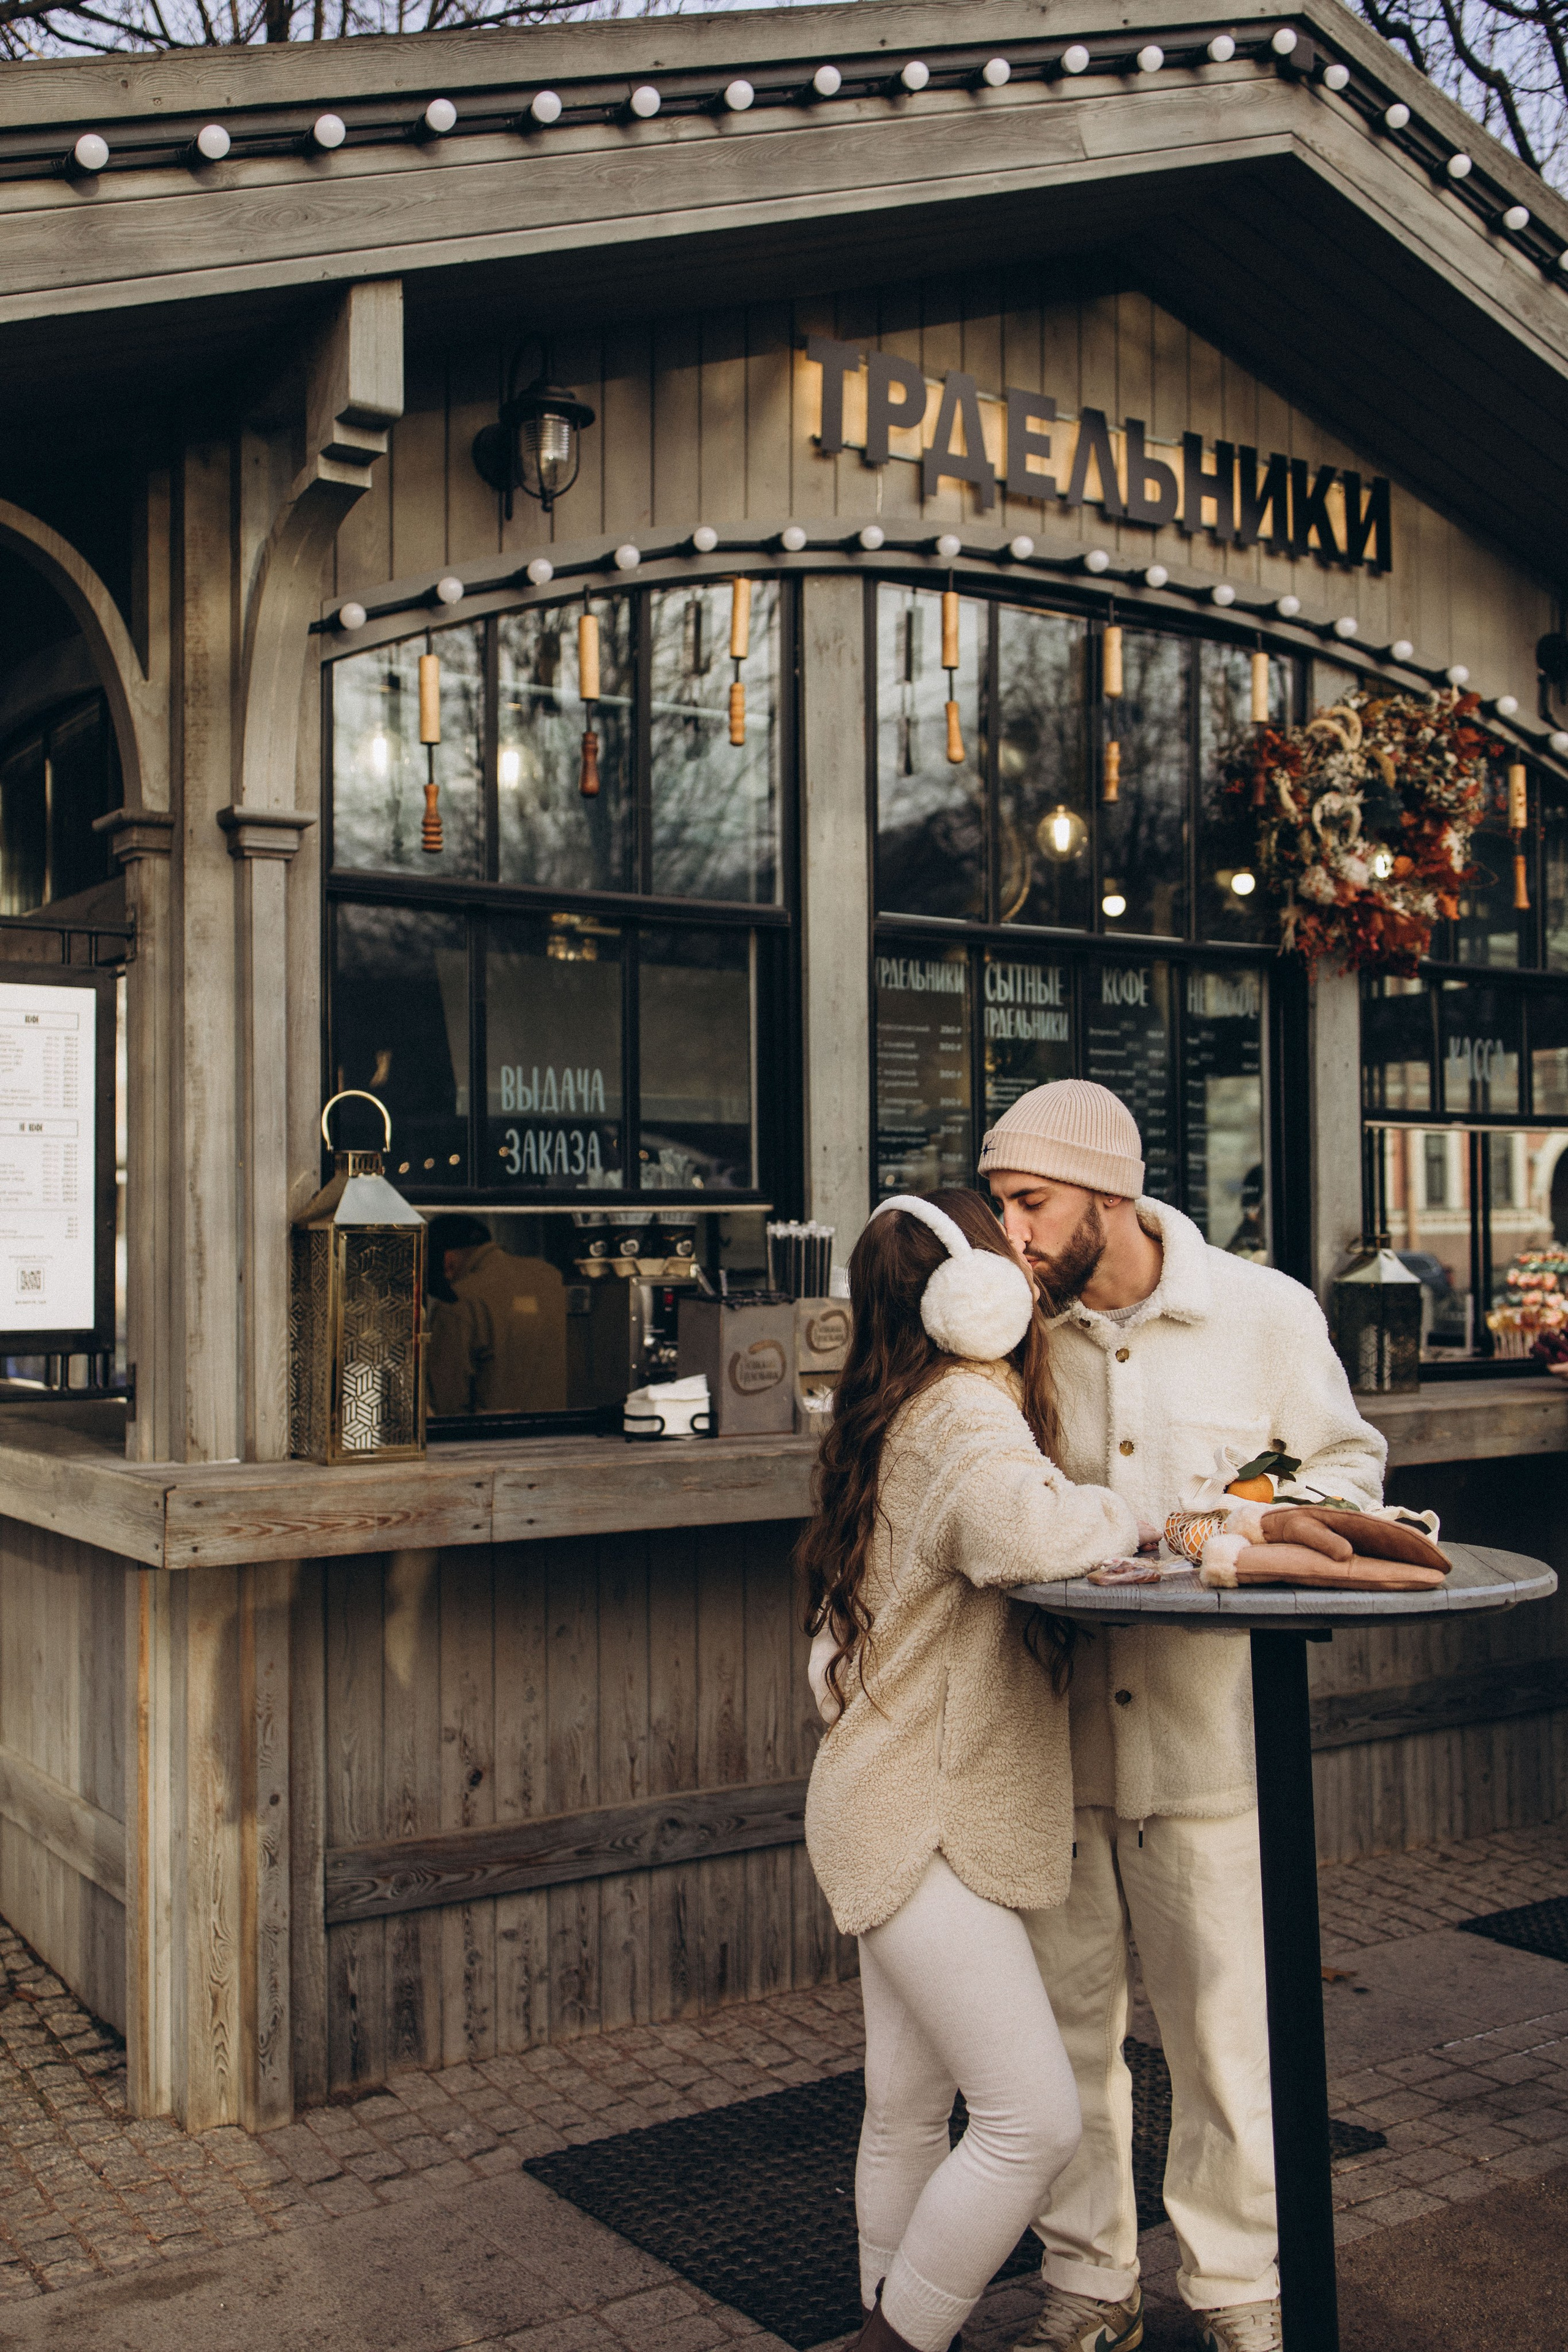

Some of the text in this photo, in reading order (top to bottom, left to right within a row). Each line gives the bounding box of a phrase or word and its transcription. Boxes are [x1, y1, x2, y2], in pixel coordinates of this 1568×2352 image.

[807, 335, 1392, 572] ТРДЕЛЬНИКИ
[984, 962, 1064, 1006] СЫТНЫЕ
[1102, 967, 1148, 1007] КОФЕ
[984, 1006, 1068, 1041] ТРДЕЛЬНИКИ
[500, 1065, 605, 1114] ВЫДАЧА
[505, 1128, 603, 1175] ЗАКАЗА
